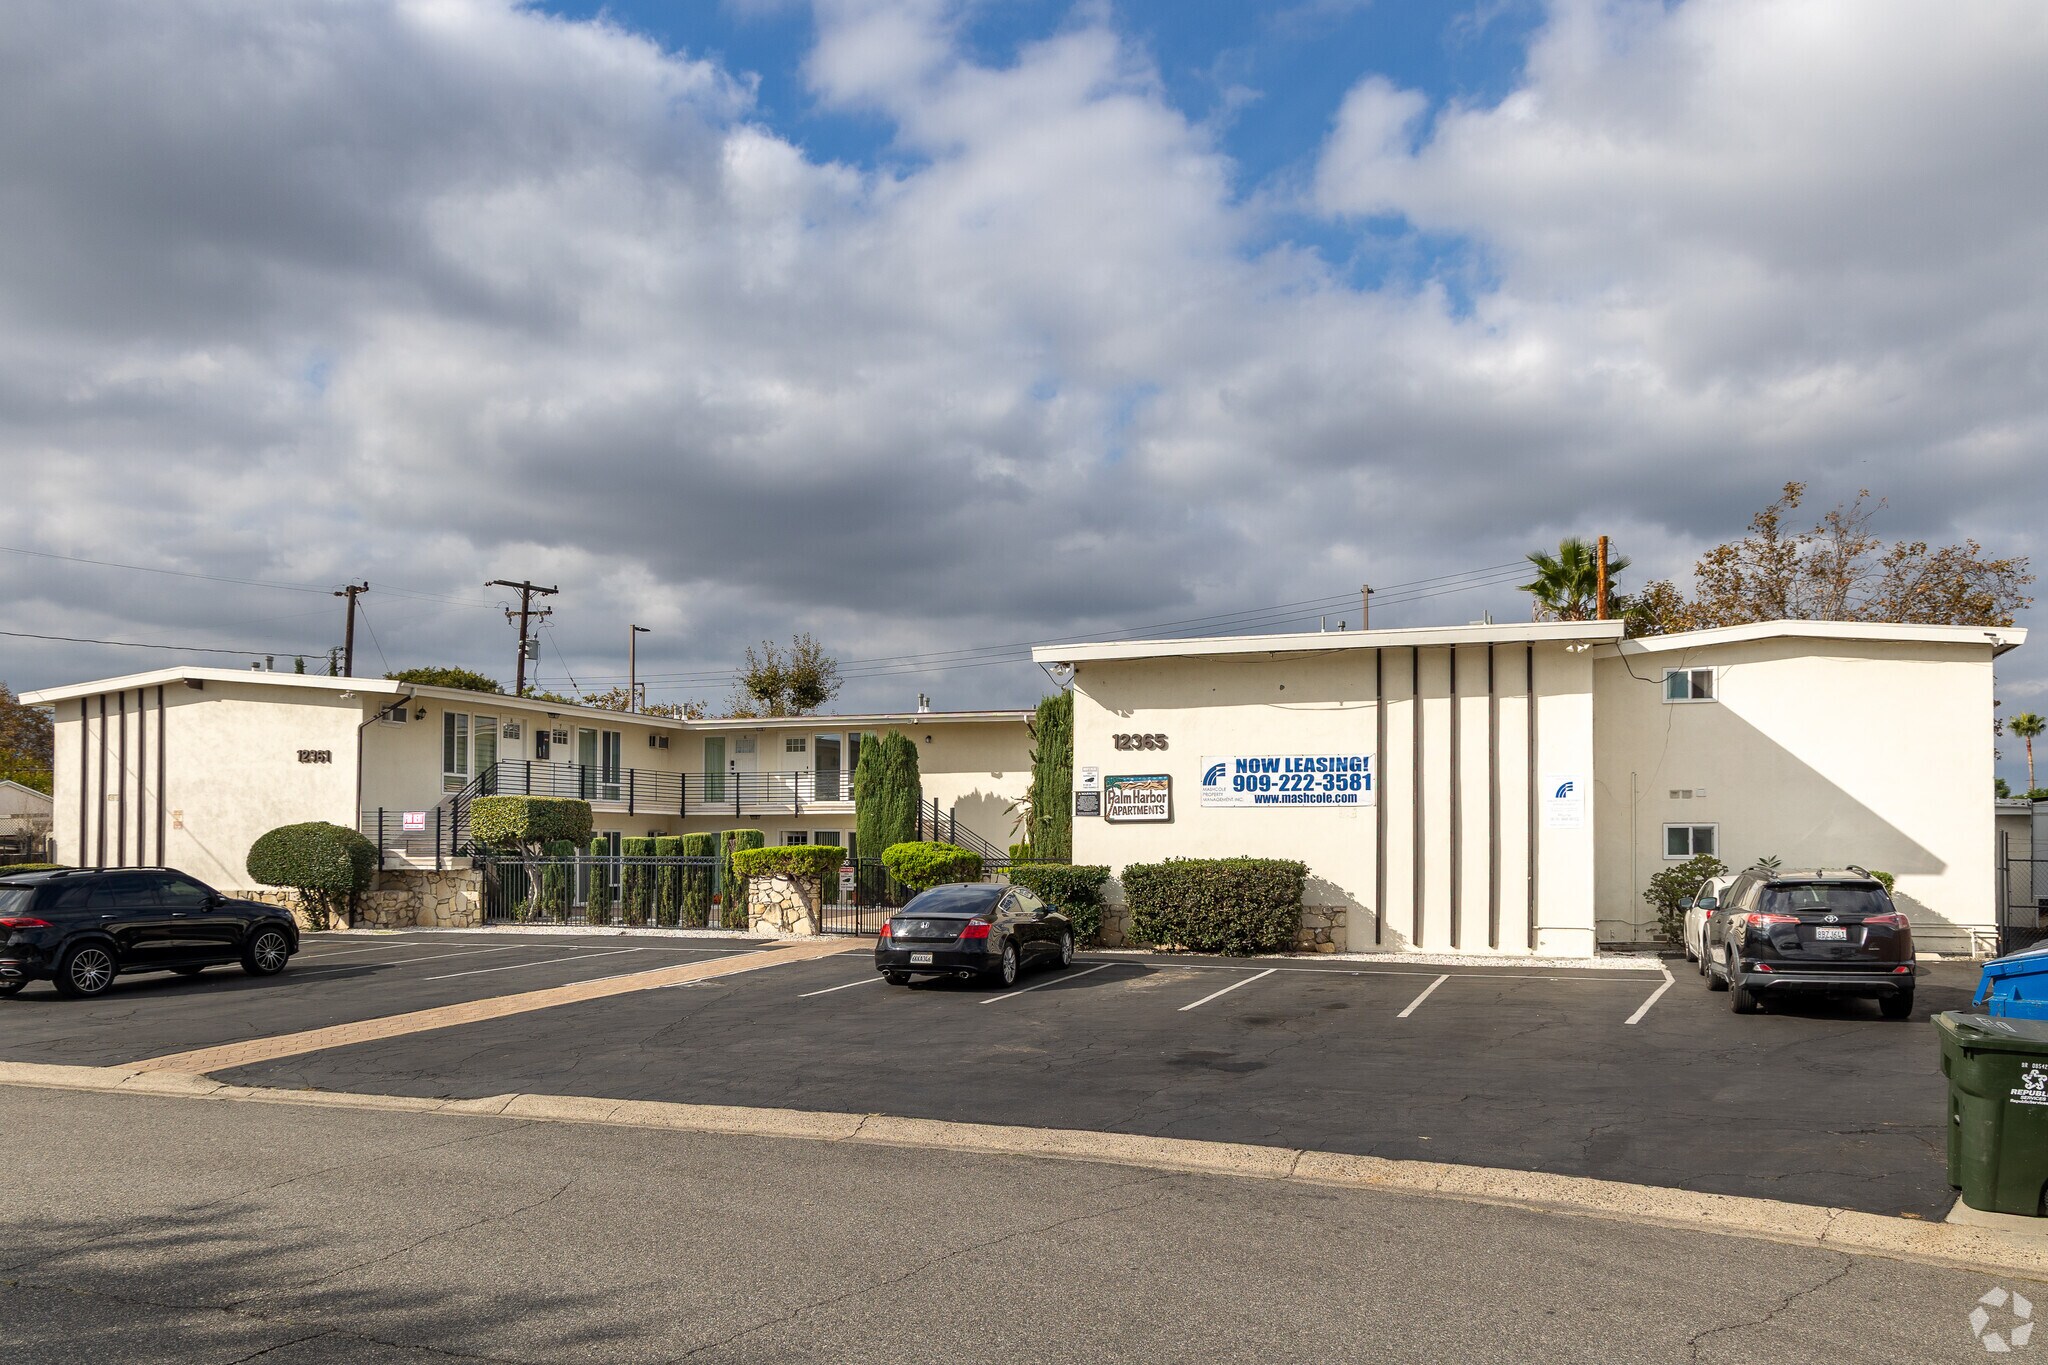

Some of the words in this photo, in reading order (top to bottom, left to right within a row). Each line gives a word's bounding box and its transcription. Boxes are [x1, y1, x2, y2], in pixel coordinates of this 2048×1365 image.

[1112, 733, 1168, 750] 12365
[297, 749, 332, 764] 12361
[1235, 758, 1281, 773] NOW
[1285, 756, 1369, 773] LEASING!
[1233, 773, 1372, 792] 909-222-3581
[1108, 789, 1132, 804] Palm
[1133, 789, 1167, 804] Harbor
[1254, 792, 1358, 804] www.mashcole.com
[1112, 804, 1165, 816] APARTMENTS
[2010, 1088, 2048, 1097] REPUBL
